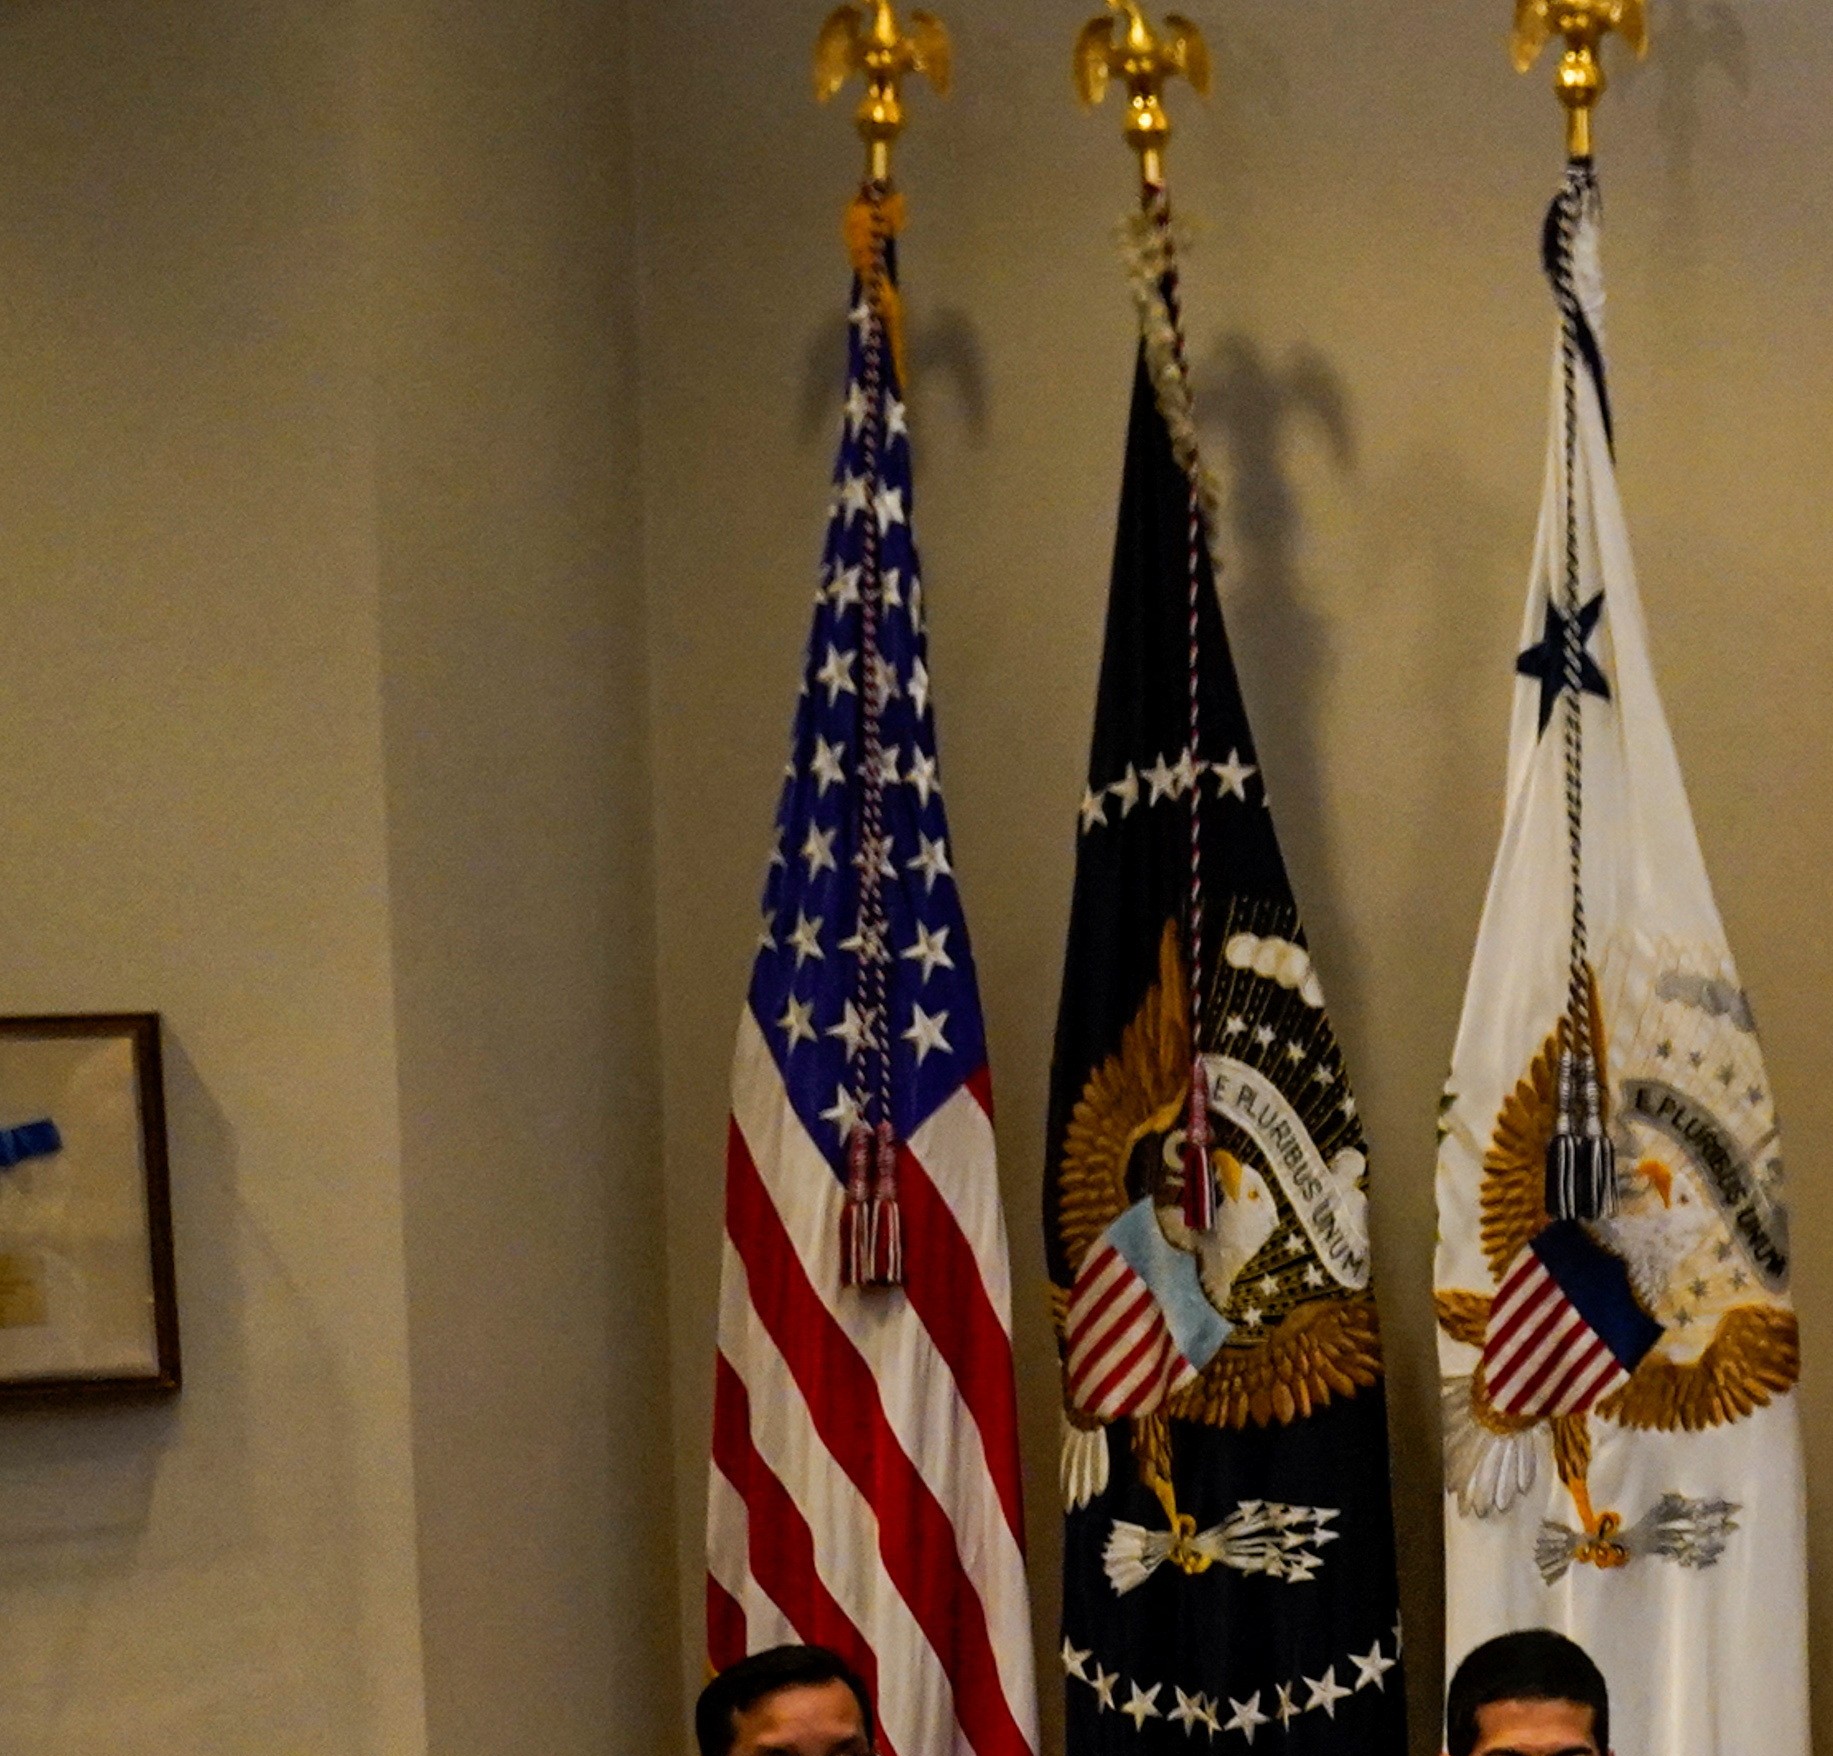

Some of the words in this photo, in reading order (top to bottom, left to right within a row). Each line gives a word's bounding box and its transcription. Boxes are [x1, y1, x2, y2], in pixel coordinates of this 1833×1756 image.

[1212, 1074, 1230, 1102] E
[1236, 1084, 1324, 1202] PLURIBUS
[1311, 1199, 1365, 1278] UNUM
[1656, 1096, 1748, 1207] PLURIBUS
[1735, 1205, 1788, 1278] UNUM
